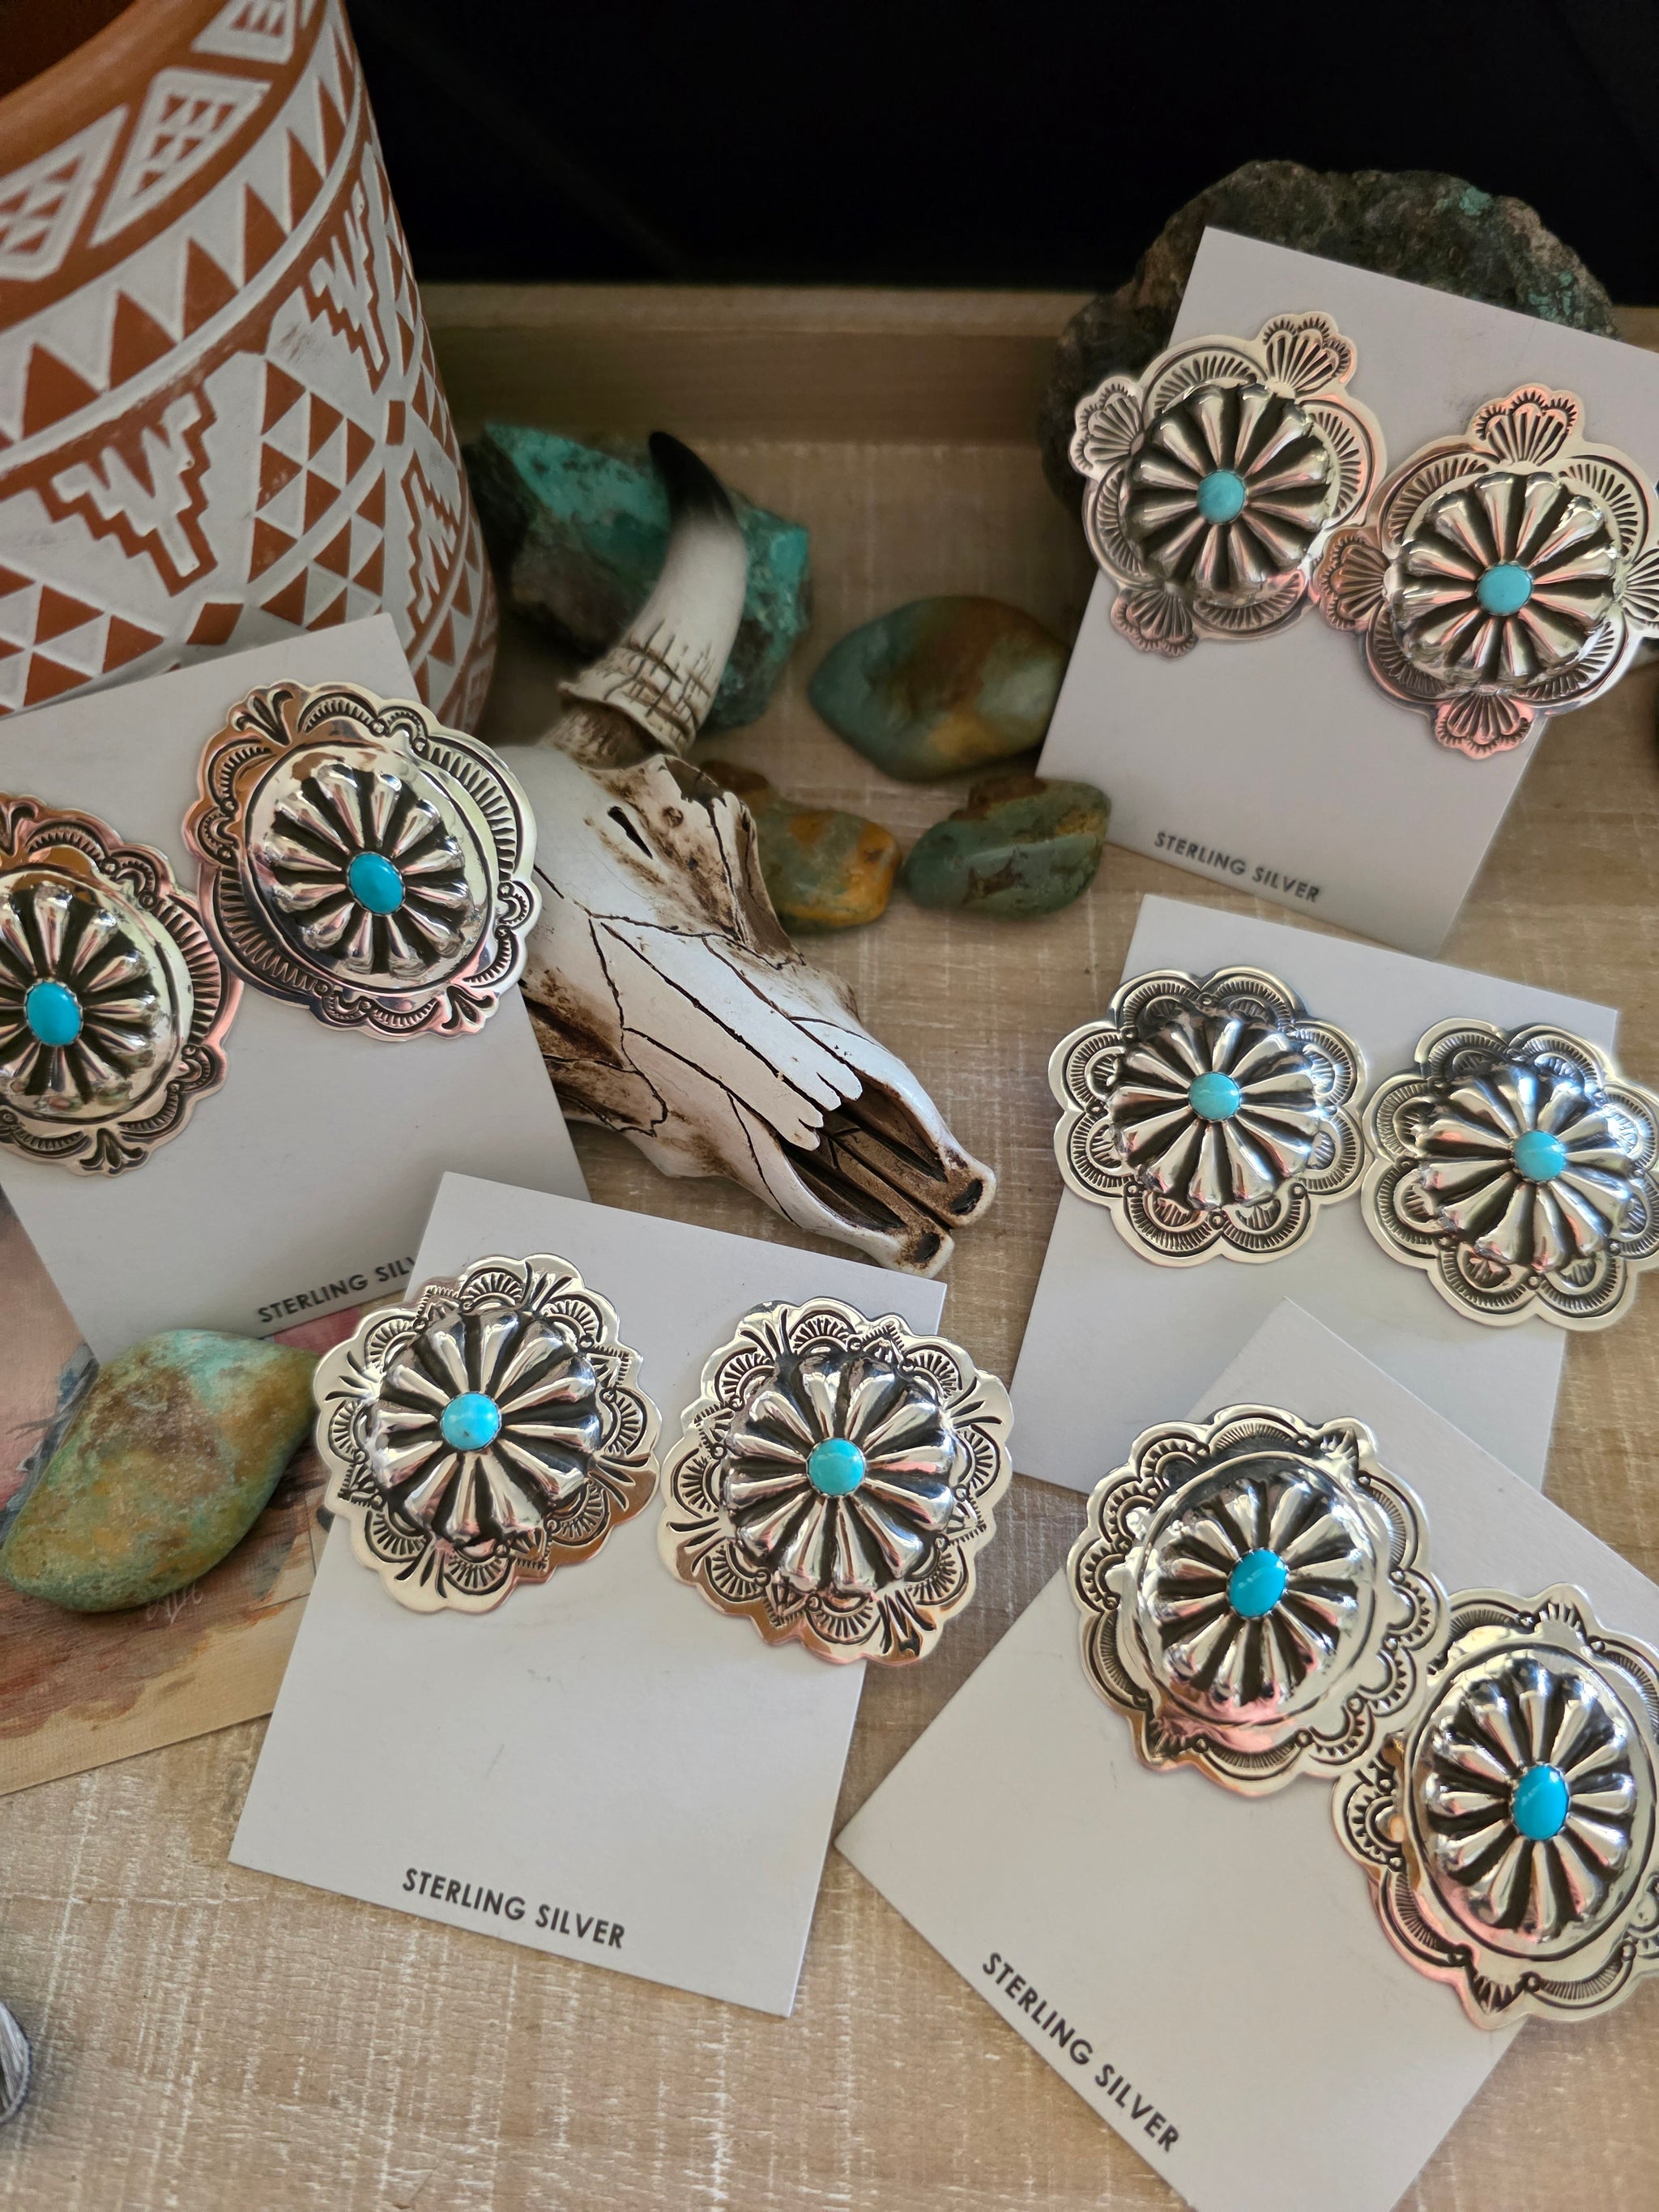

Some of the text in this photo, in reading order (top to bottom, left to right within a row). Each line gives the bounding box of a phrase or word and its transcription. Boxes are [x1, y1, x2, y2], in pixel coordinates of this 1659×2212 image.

[1154, 832, 1321, 902] STERLING SILVER
[258, 1274, 368, 1322] STERLING
[403, 1868, 625, 1948] STERLING SILVER
[983, 1953, 1179, 2152] STERLING SILVER
